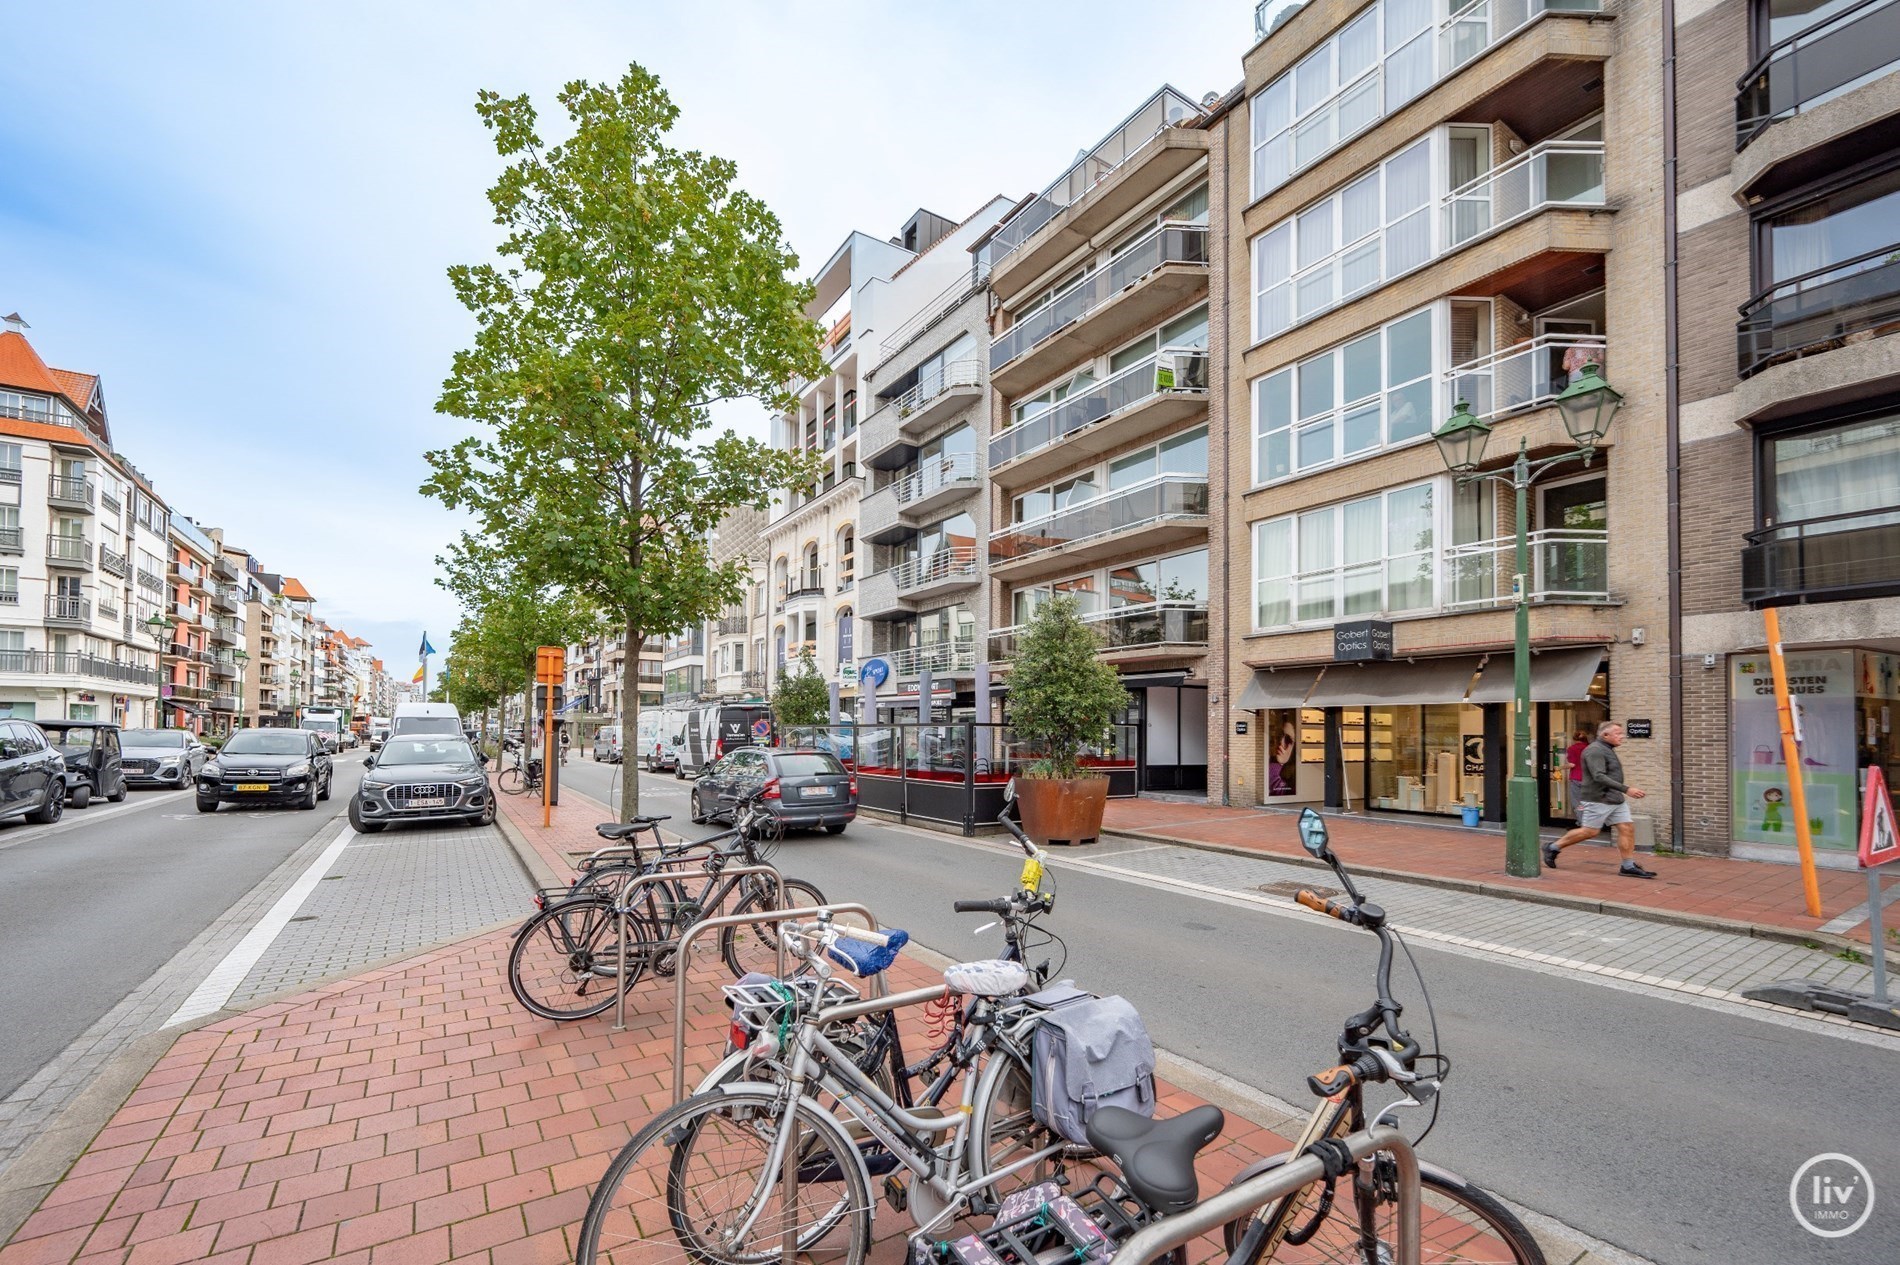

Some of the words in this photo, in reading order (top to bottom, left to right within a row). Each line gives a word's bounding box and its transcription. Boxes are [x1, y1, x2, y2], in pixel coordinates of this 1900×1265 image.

[1336, 629, 1369, 640] Gobert
[1371, 629, 1390, 639] Gobert
[1338, 641, 1367, 651] Optics
[1372, 640, 1390, 650] Optics
[1758, 658, 1842, 673] HSTIA
[1753, 676, 1827, 686] DIESTEN
[1755, 685, 1825, 695] CHQUES
